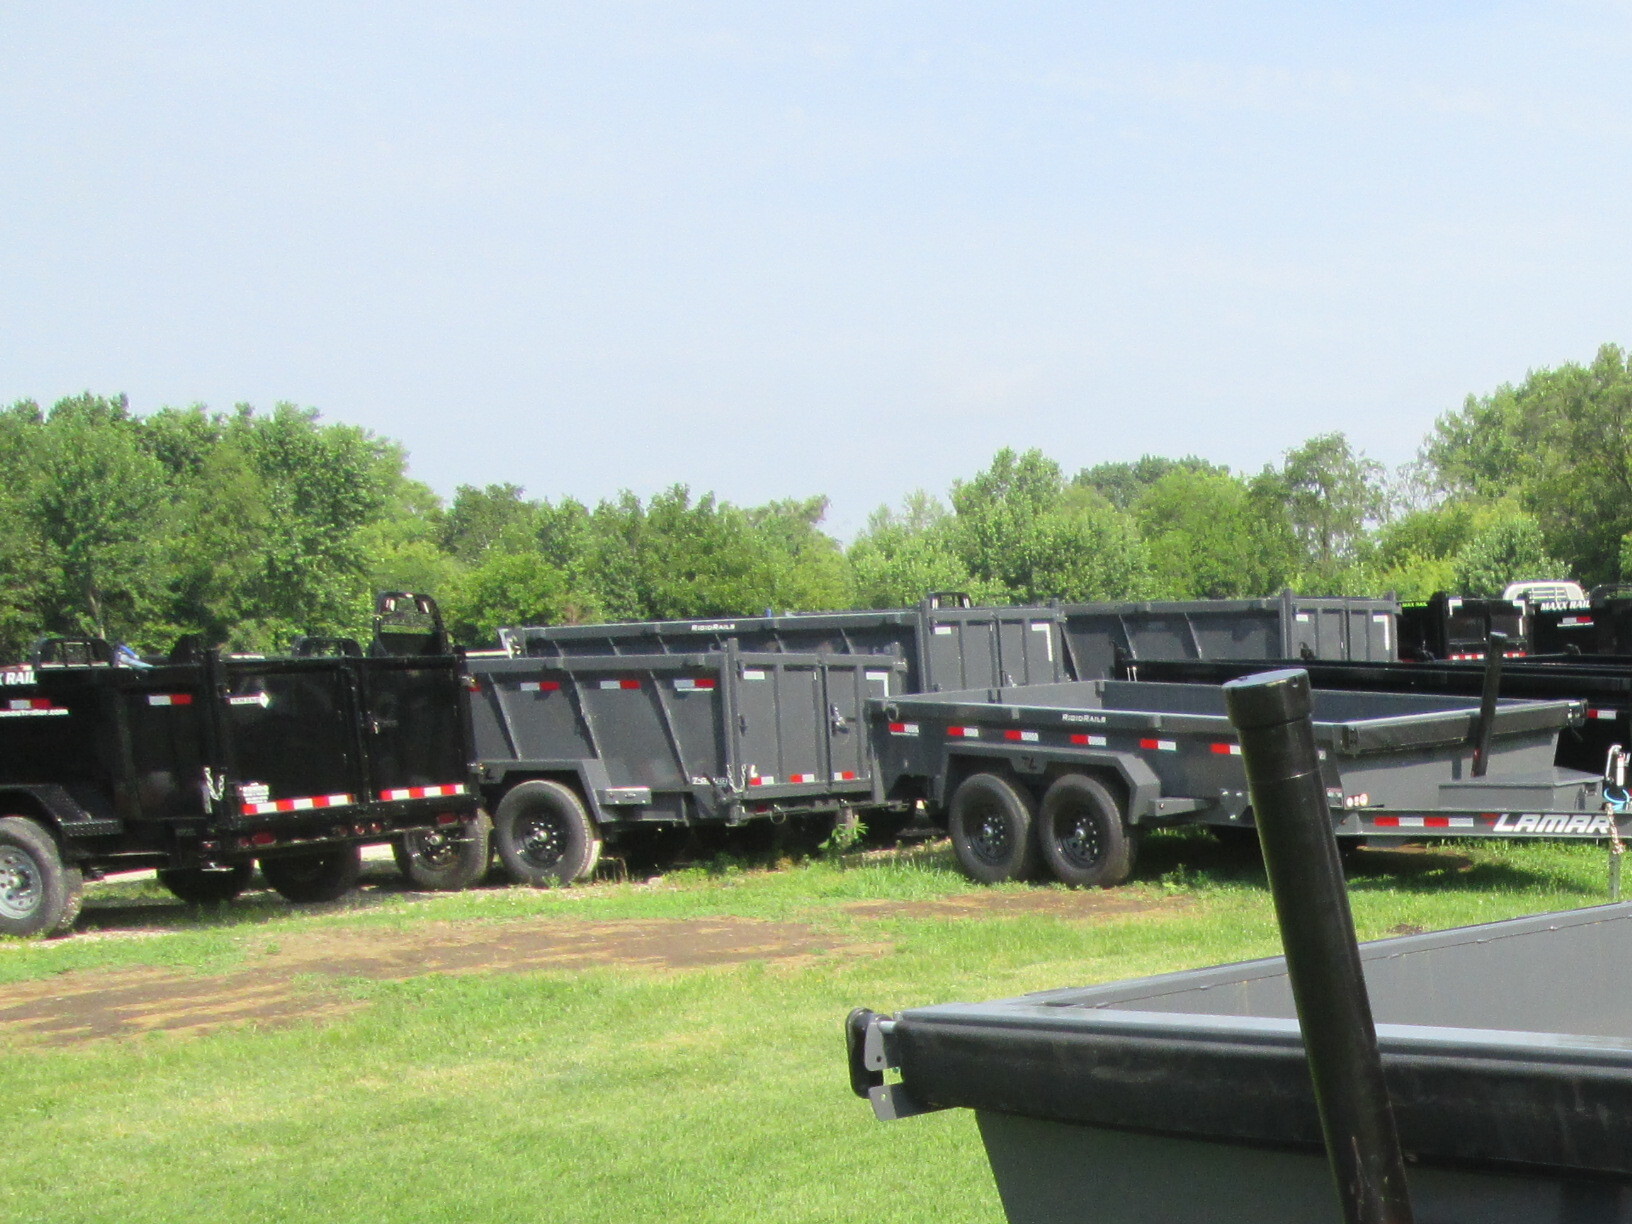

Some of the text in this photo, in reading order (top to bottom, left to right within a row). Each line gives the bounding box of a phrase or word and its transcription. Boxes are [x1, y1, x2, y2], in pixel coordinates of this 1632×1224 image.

[1541, 600, 1590, 611] MAXX RAIL
[5, 671, 38, 685] RAIL
[1493, 813, 1610, 833] LAMAR
